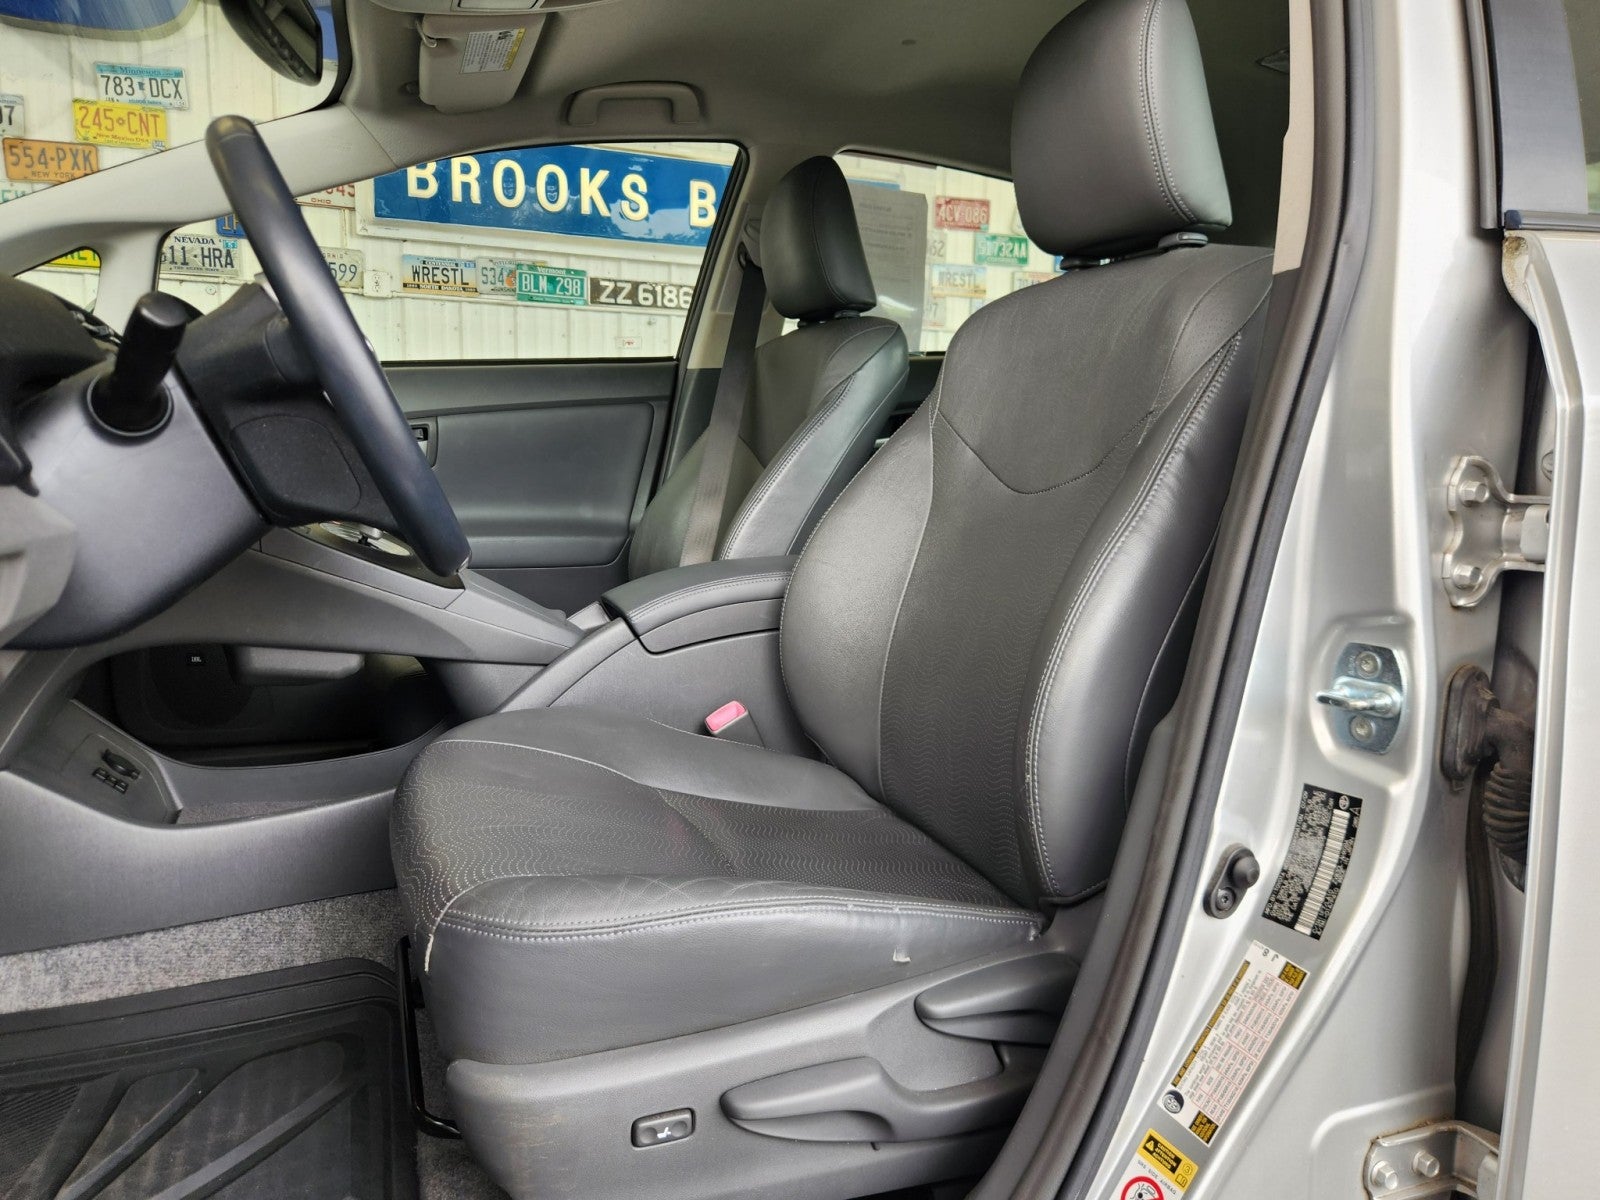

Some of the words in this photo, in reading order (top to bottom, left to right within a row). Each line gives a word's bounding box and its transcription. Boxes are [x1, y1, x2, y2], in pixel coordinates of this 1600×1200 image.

[100, 74, 135, 96] 783
[149, 78, 182, 99] DCX
[79, 106, 114, 131] 245
[127, 111, 160, 137] CNT
[9, 145, 94, 171] 554-PXK
[55, 171, 75, 180] YORK
[406, 155, 649, 222] BROOKS
[174, 236, 215, 245] NEVADA
[201, 247, 234, 268] HRA
[412, 265, 469, 286] WRESTL
[537, 267, 566, 275] Vermont
[556, 278, 581, 296] 298
[599, 280, 632, 304] ZZ
[638, 283, 693, 309] 6186
